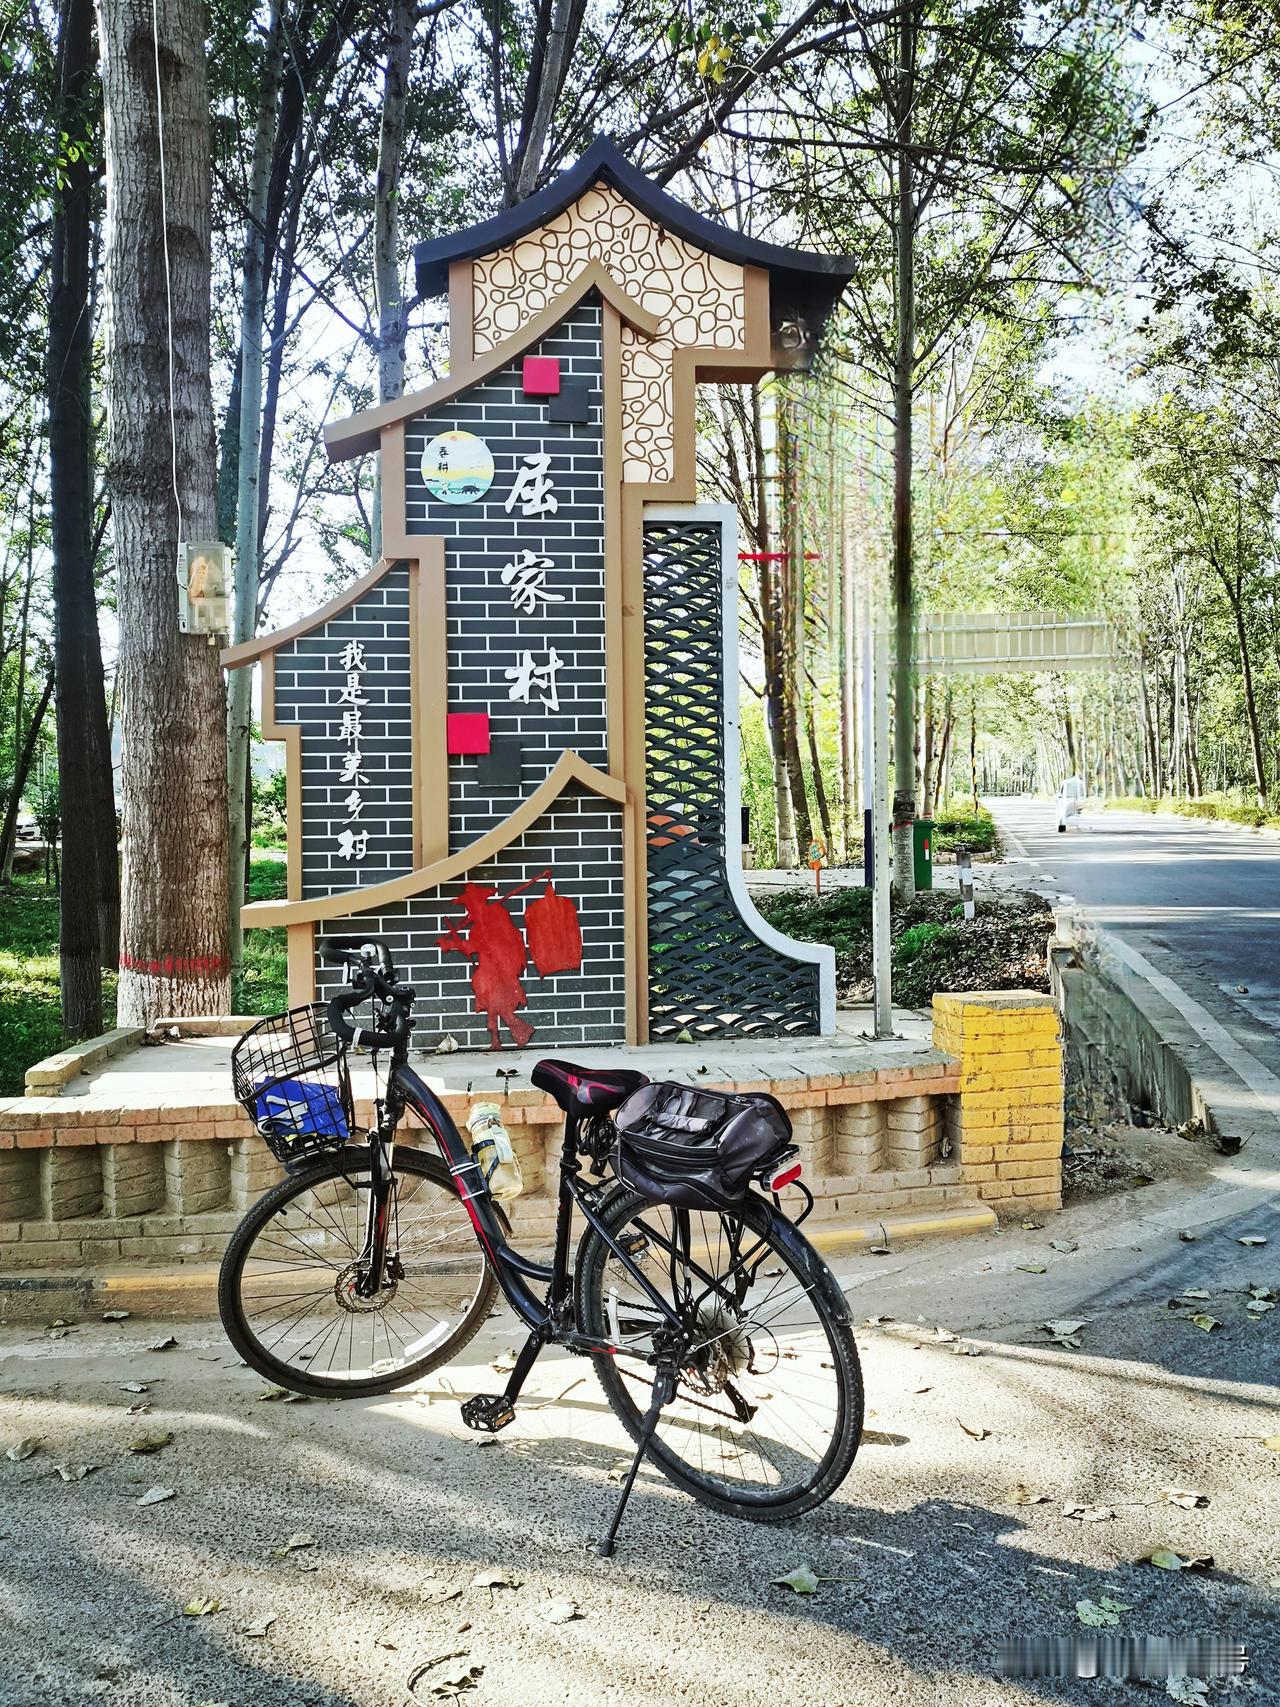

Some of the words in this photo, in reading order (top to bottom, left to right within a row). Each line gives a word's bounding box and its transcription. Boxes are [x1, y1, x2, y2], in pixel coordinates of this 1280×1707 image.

[501, 452, 566, 711] 屈家村
[337, 640, 371, 861] 我是最美乡村
